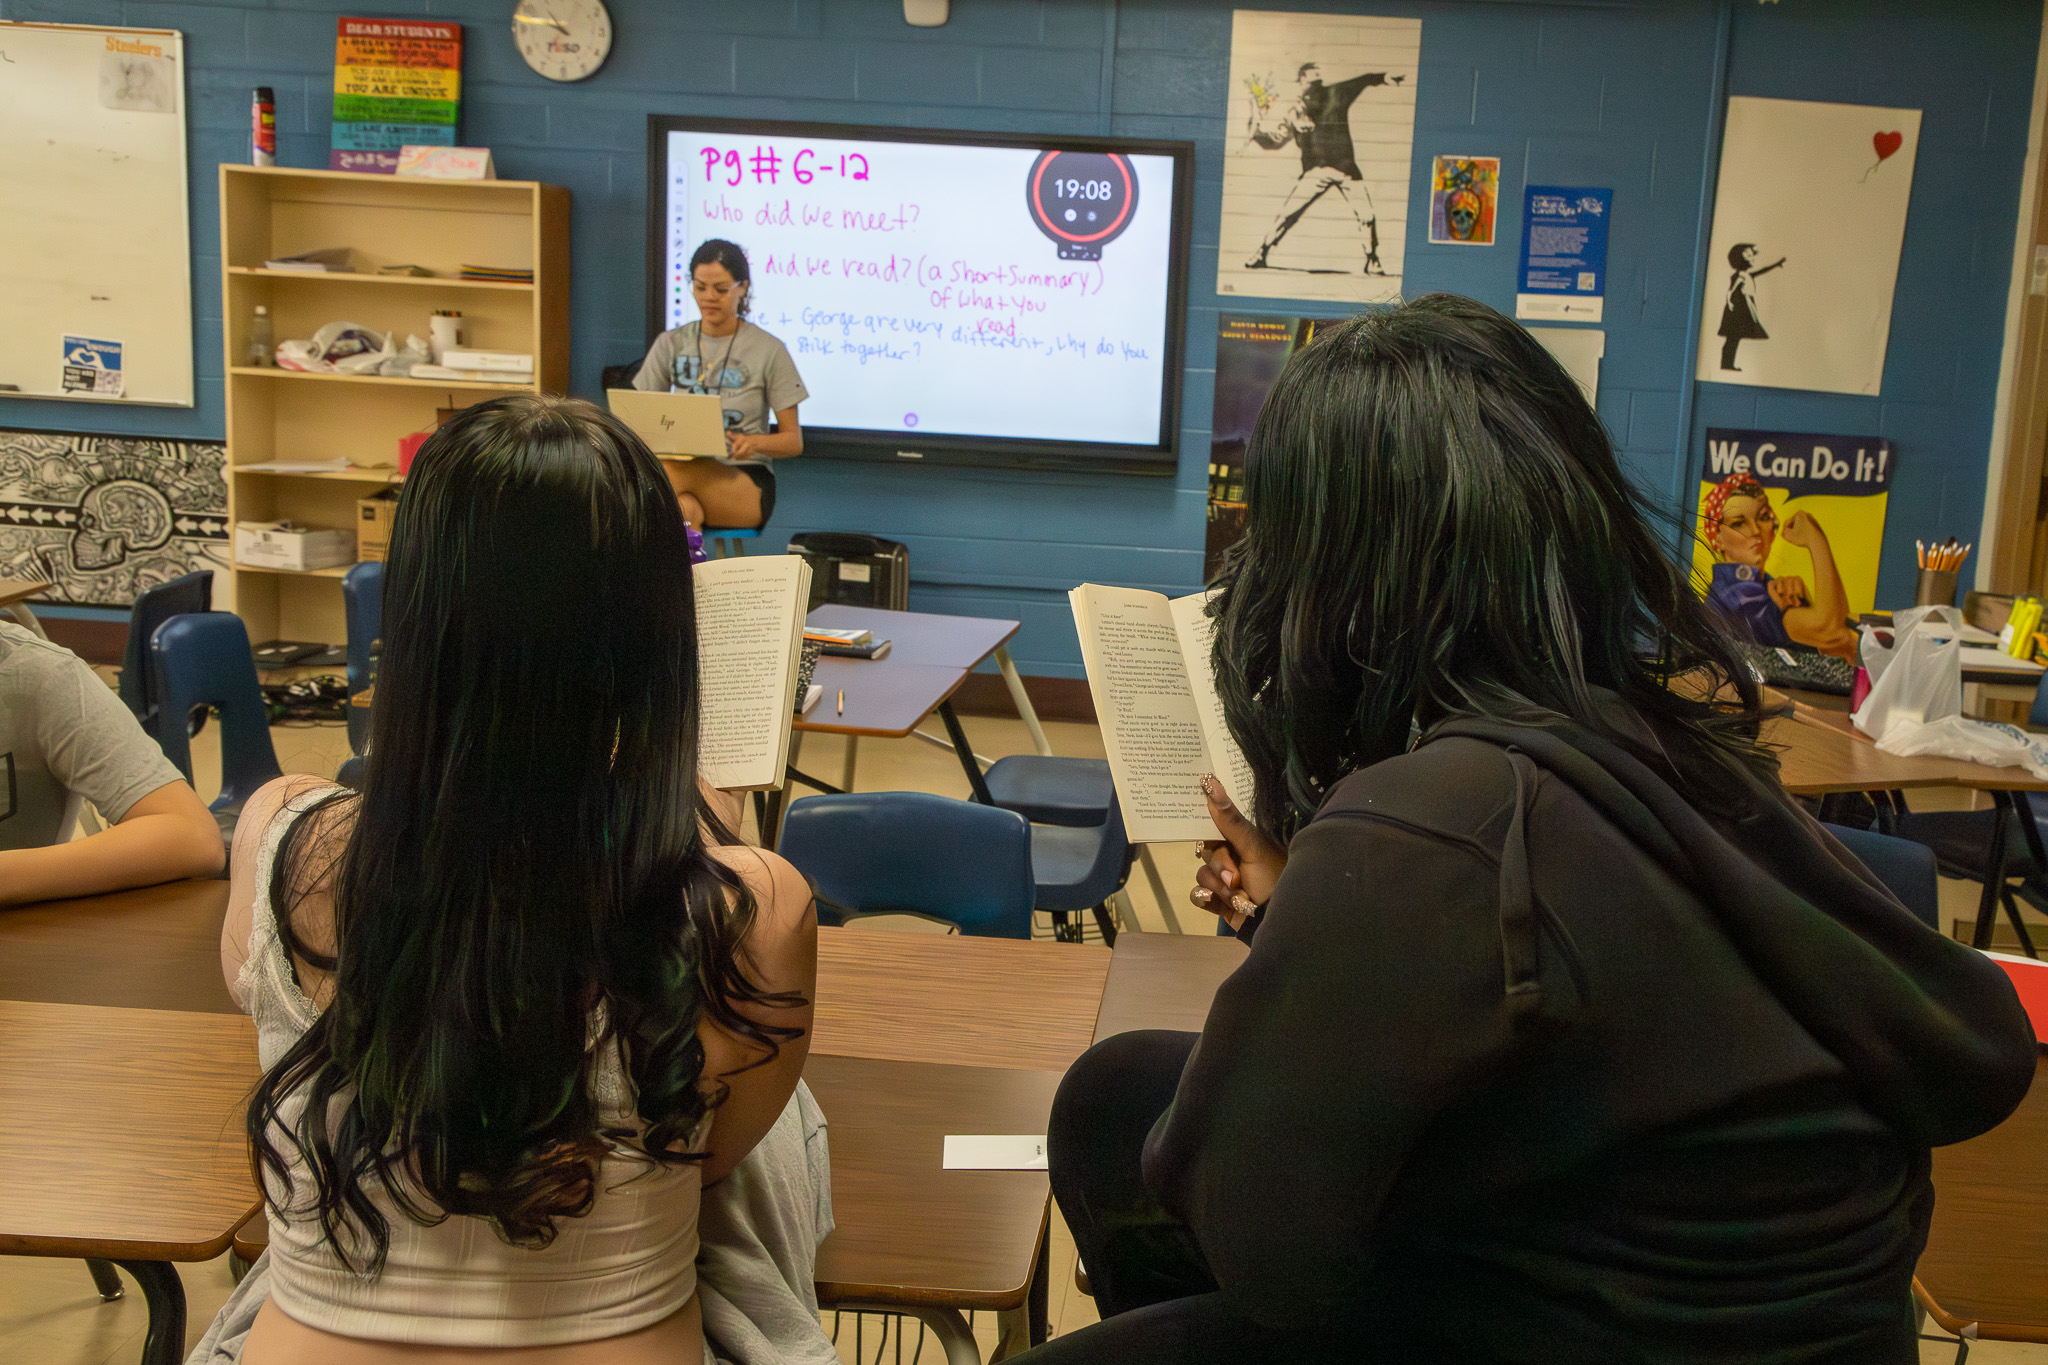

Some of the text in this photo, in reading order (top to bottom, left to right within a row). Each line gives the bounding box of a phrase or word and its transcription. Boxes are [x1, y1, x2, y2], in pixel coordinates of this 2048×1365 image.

[105, 35, 162, 57] Steelers
[346, 23, 452, 38] DEAR STUDENTS
[793, 148, 869, 185] 6-12
[1054, 178, 1112, 201] 19:08
[755, 199, 795, 227] did
[843, 202, 920, 232] meet?
[765, 253, 800, 277] did
[842, 253, 912, 286] read?
[802, 306, 860, 336] George
[864, 314, 899, 333] are
[904, 317, 944, 339] very
[1096, 336, 1115, 357] do
[977, 317, 1016, 338] read
[1708, 440, 1888, 483] We Can Do It!
